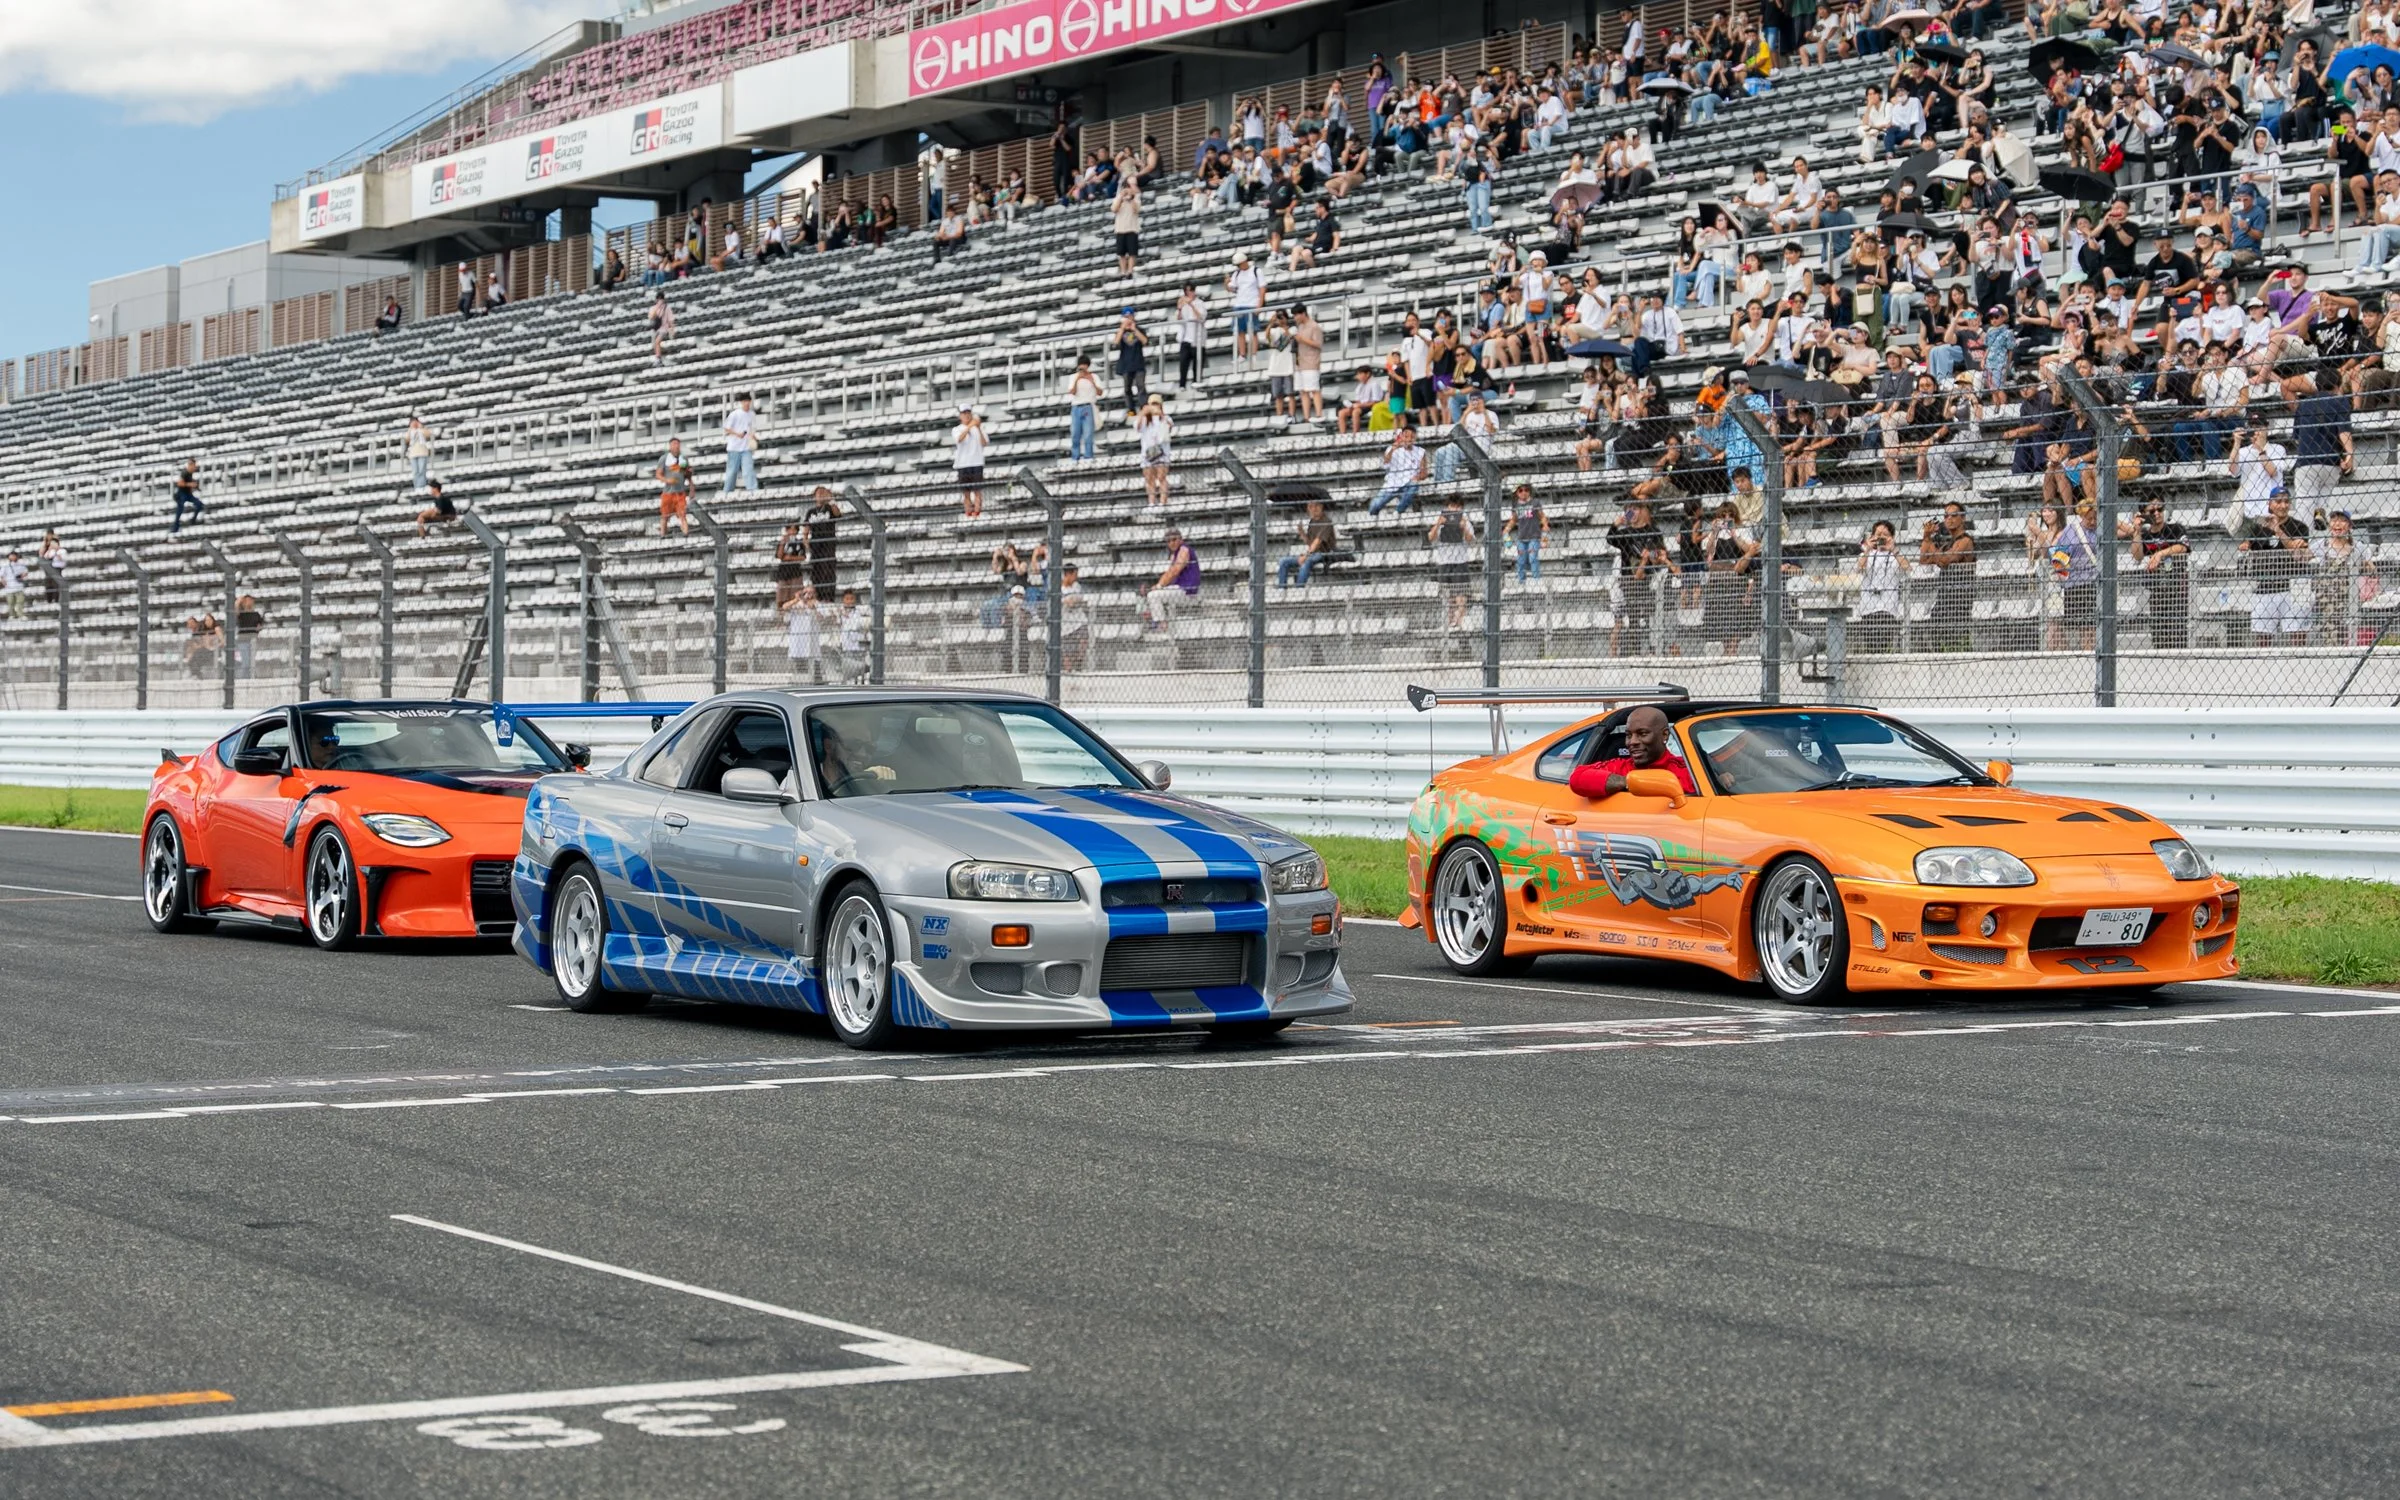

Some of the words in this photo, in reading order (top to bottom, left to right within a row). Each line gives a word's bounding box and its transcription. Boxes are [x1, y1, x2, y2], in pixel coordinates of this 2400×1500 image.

[952, 15, 1054, 74] HINO
[665, 101, 698, 117] TOYOTA
[557, 131, 587, 146] TOYOTA
[631, 125, 660, 154] GR
[662, 131, 692, 145] Racing
[526, 153, 552, 180] GR
[554, 160, 582, 172] Racing
[430, 179, 455, 204] GR
[306, 206, 327, 230] GR
[924, 918, 948, 929] NX
[2120, 923, 2144, 941] 80
[1851, 964, 1891, 974] STILLEN
[2056, 955, 2149, 974] 12
